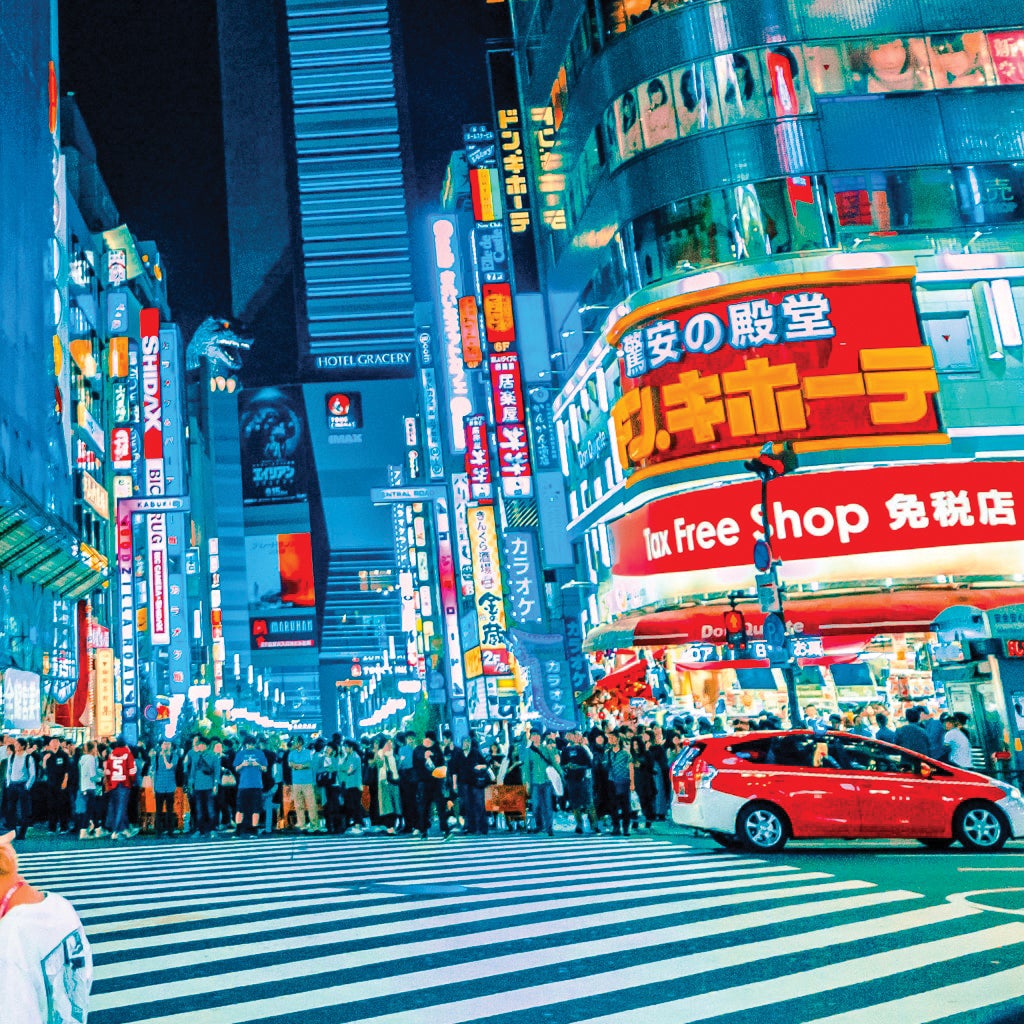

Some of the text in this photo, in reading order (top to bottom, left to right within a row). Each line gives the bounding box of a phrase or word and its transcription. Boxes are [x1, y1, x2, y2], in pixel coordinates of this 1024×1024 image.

[318, 352, 412, 367] HOTEL GRACERY
[622, 292, 836, 377] 驚安の殿堂
[142, 335, 163, 432] SHIDAX
[149, 468, 161, 496] BIC
[150, 513, 164, 545] RUG
[644, 488, 1017, 562] Tax Free Shop 免税店
[511, 537, 536, 617] カラオケ
[271, 620, 314, 633] MARUHAN
[479, 592, 507, 647] 金の蔵
